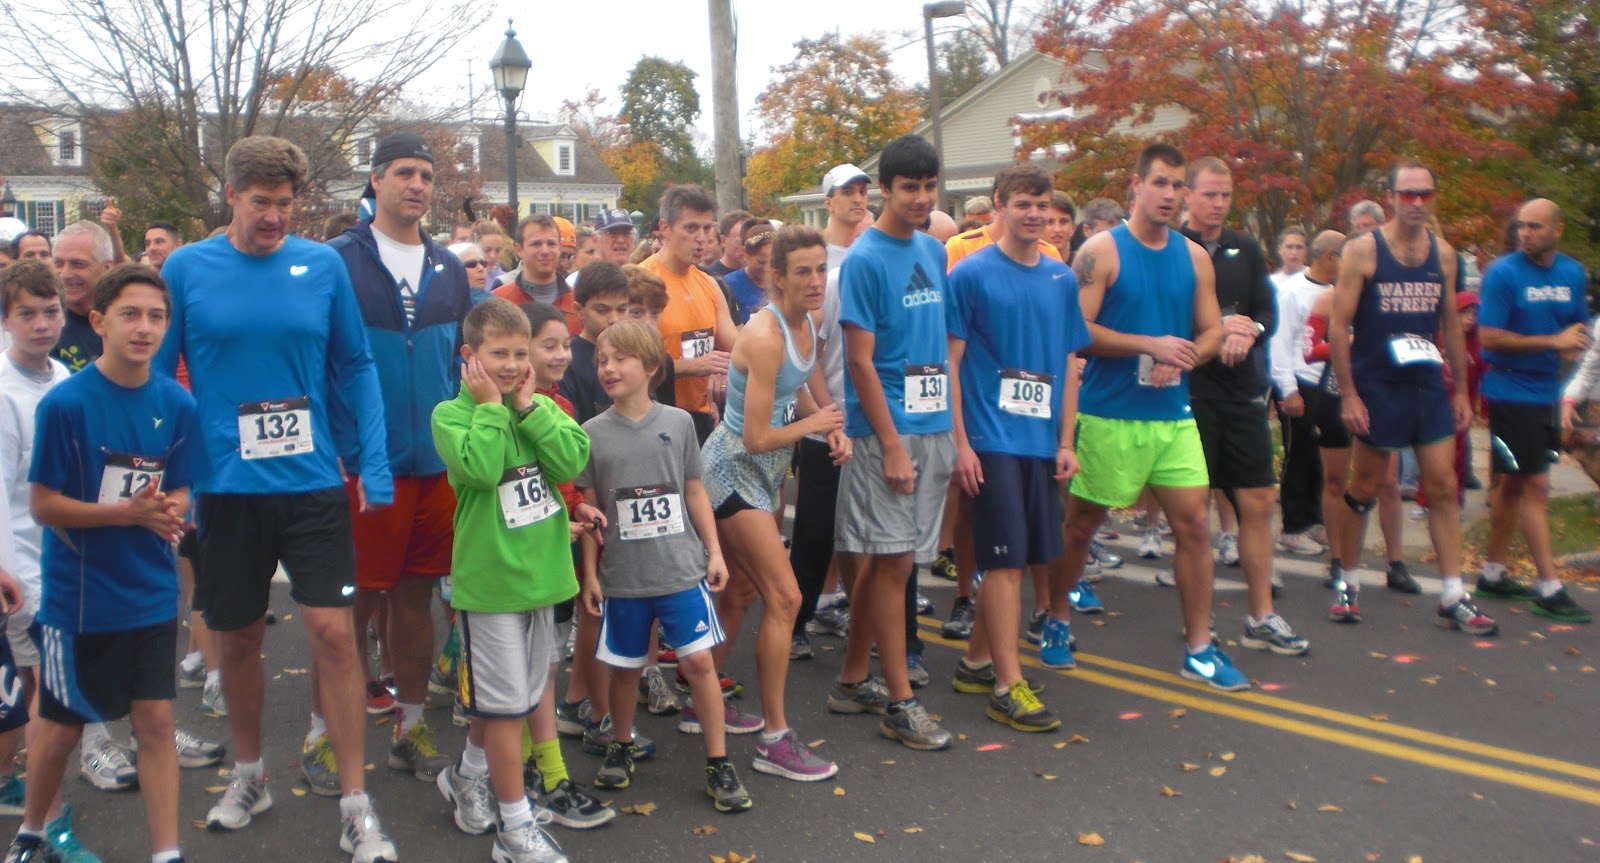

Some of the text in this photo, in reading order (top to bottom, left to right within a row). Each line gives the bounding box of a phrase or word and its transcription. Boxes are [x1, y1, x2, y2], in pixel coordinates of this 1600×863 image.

[902, 287, 942, 308] adidas
[1378, 282, 1441, 297] WARREN
[1381, 297, 1439, 312] STREET
[920, 376, 942, 398] 131
[1012, 381, 1044, 403] 108
[255, 413, 299, 440] 132
[513, 474, 548, 507] 169
[630, 497, 671, 523] 143
